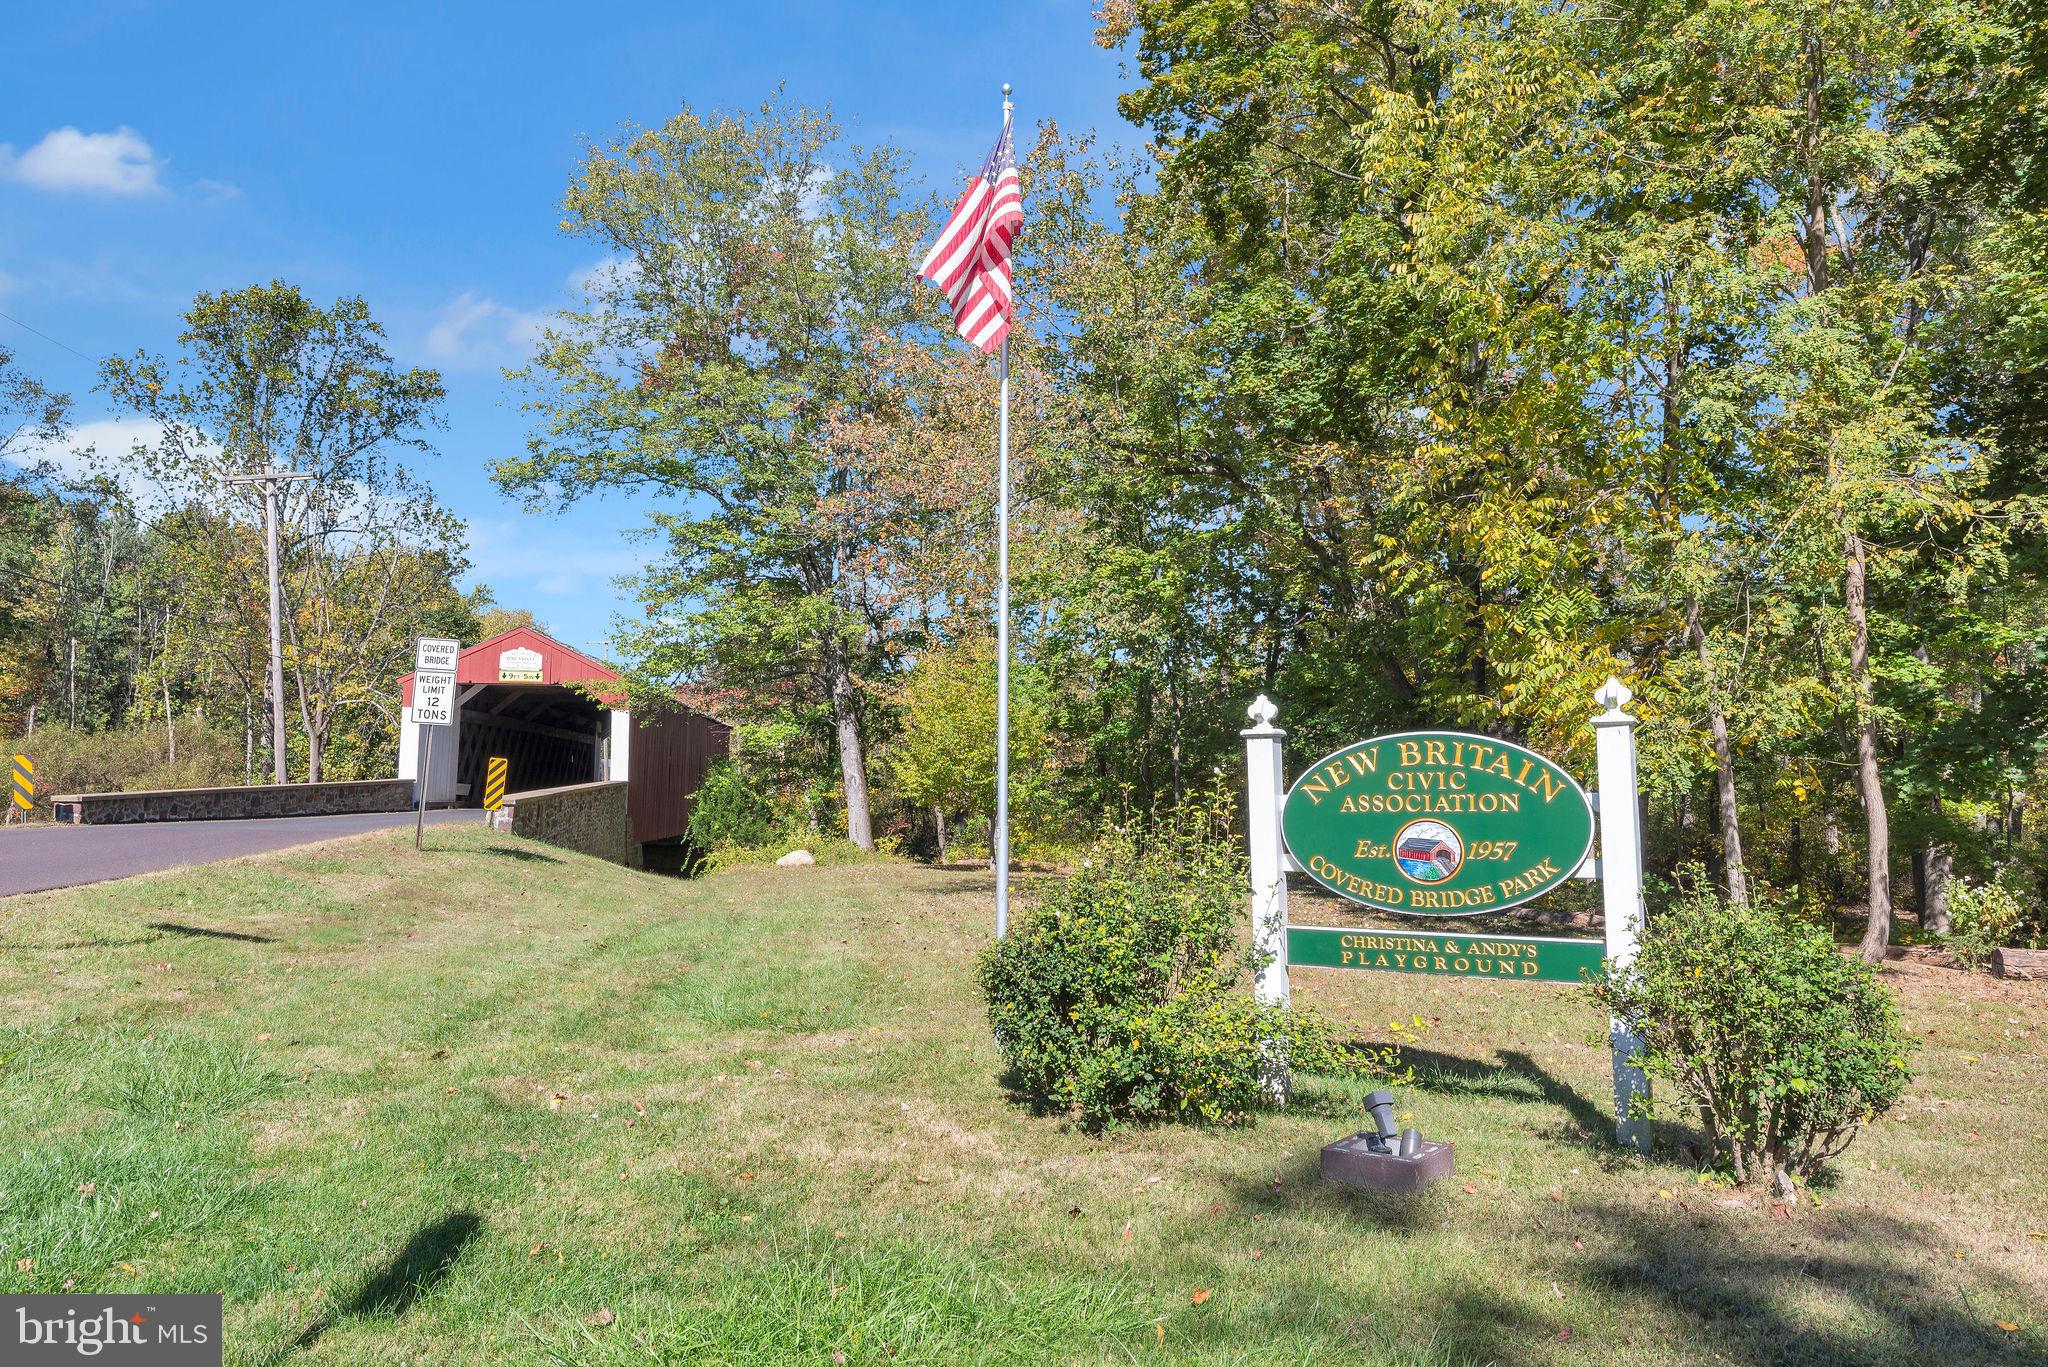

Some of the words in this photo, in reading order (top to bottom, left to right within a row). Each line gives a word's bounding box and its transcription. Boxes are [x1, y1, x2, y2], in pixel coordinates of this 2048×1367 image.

[422, 644, 454, 654] COVERED
[424, 656, 450, 665] BRIDGE
[419, 676, 452, 684] WEIGHT
[422, 686, 446, 694] LIMIT
[428, 697, 440, 706] 12
[418, 708, 446, 720] TONS
[1300, 746, 1379, 805] NEW
[1398, 740, 1566, 804] BRITAIN
[1387, 771, 1466, 790] CIVIC
[1340, 793, 1520, 813] ASSOCIATION
[1354, 840, 1392, 858] Est.
[1467, 841, 1518, 861] 1957
[1310, 855, 1404, 905] COVERED
[1411, 885, 1495, 908] BRIDGE
[1499, 857, 1561, 899] PARK
[1341, 935, 1438, 953] CHRISTINA
[1444, 940, 1461, 953] &
[1468, 942, 1537, 958] ANDY'S
[1342, 951, 1539, 976] PLAYGROUND
